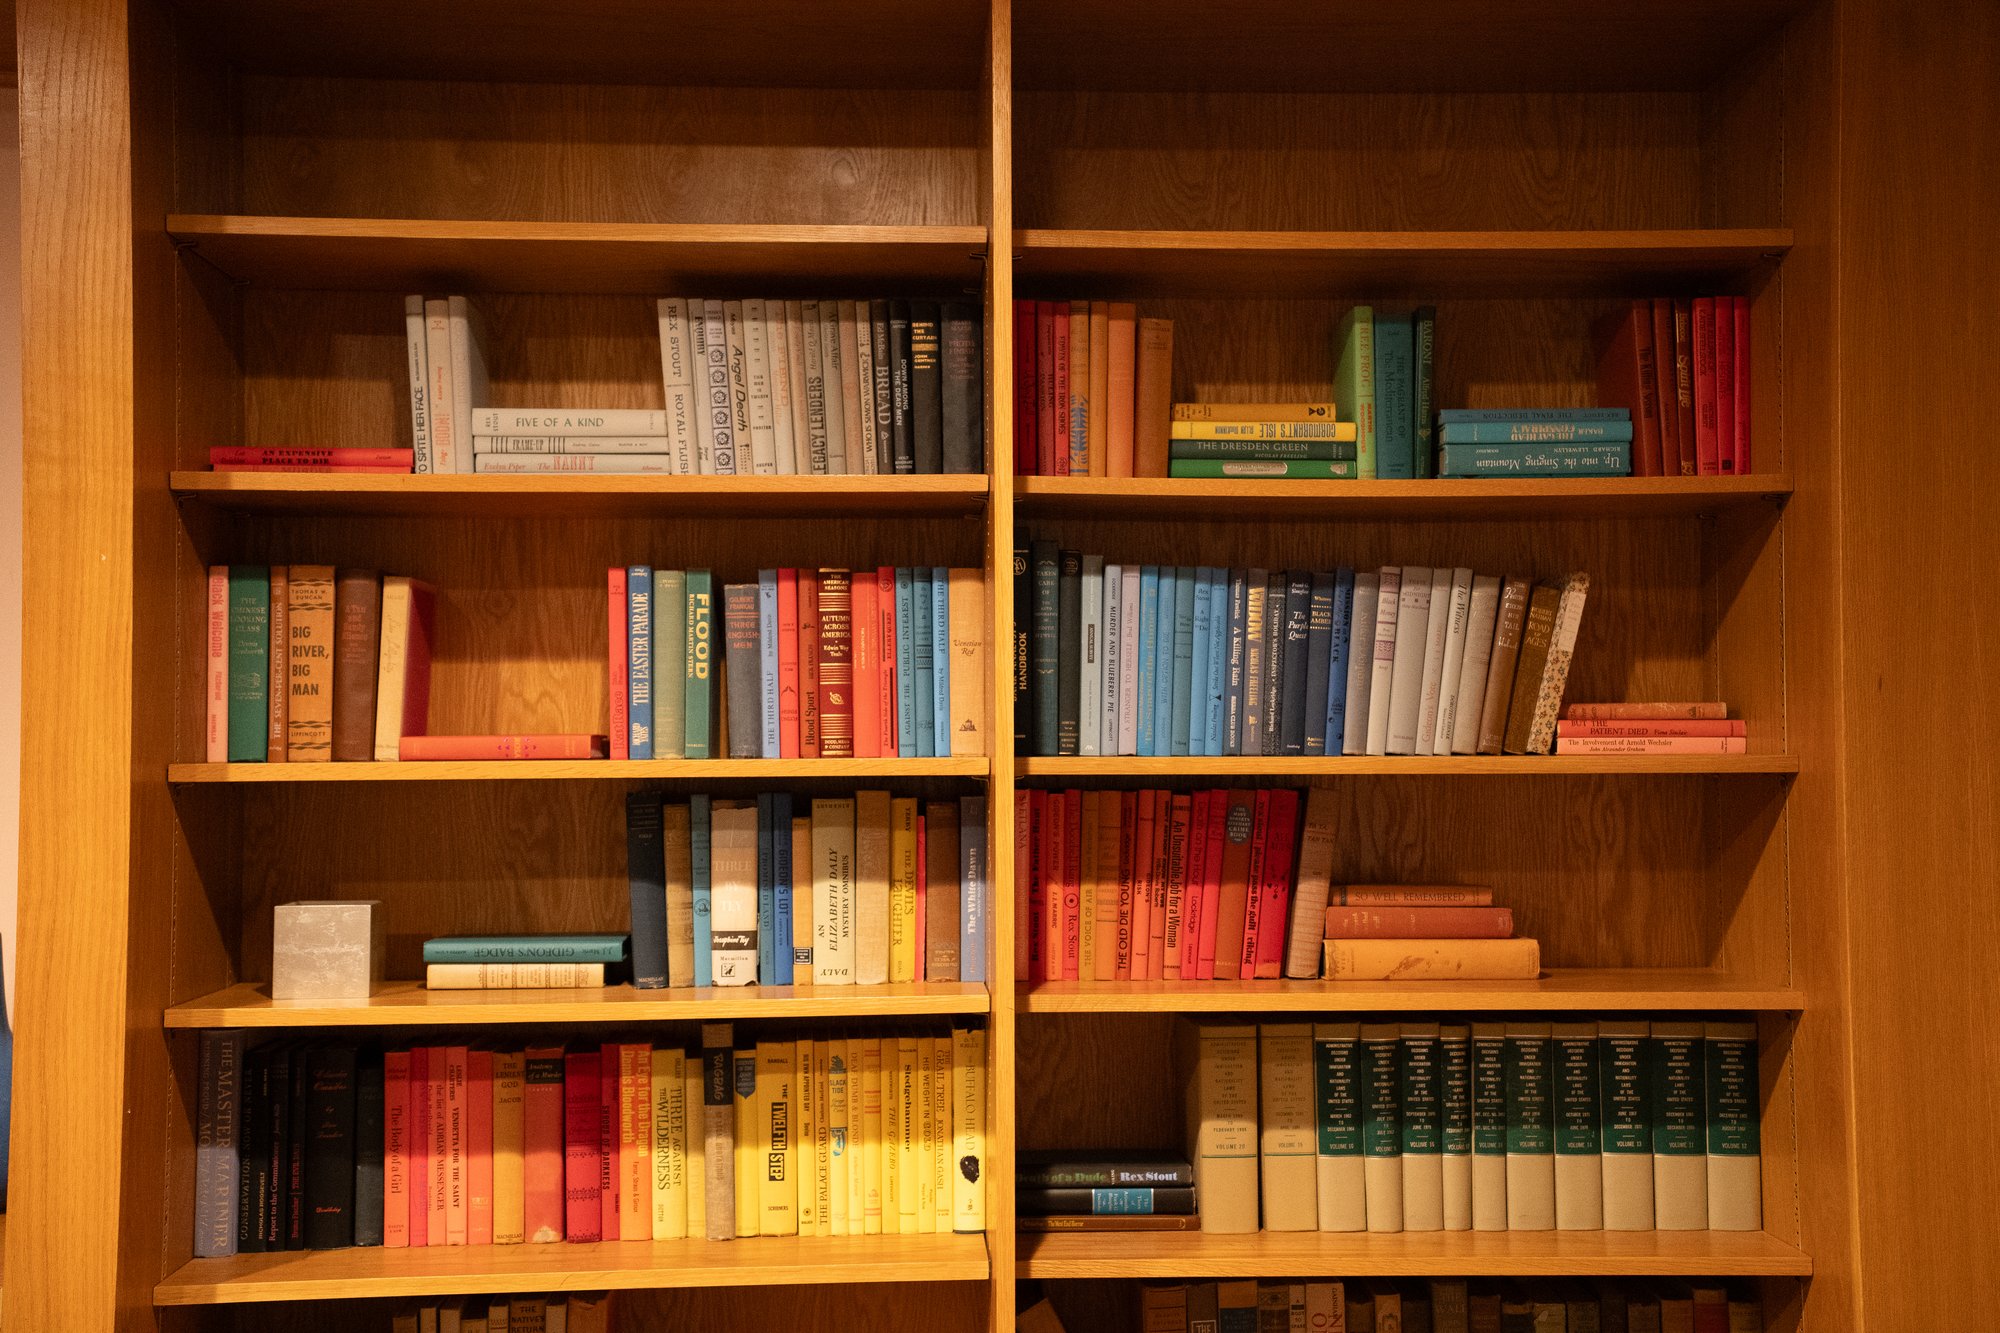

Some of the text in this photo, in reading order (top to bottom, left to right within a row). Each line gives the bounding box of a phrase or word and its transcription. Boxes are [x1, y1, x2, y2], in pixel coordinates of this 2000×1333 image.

[667, 304, 682, 378] REX STOUT
[730, 344, 748, 432] Angel Death
[875, 365, 891, 425] BREAD
[516, 417, 605, 428] FIVE OF A KIND
[1196, 441, 1309, 452] THE DRESDEN GREEN
[1476, 452, 1621, 470] Up, into the Singing Mountain
[821, 615, 851, 623] AUTUMN
[823, 623, 850, 631] ACROSS
[1108, 605, 1116, 637] MURDER
[1248, 586, 1265, 643] WIDOW
[1453, 583, 1467, 635] The Witness
[291, 626, 311, 638] BIG
[631, 592, 649, 706] THE EASTER PARADE
[695, 593, 710, 680] FLOOD
[821, 631, 851, 639] AMERICA
[961, 647, 975, 657] Red
[1108, 639, 1116, 656] AND
[291, 645, 330, 660] RIVER,
[291, 664, 311, 677] BIG
[901, 596, 911, 736] AGAINST THE PUBLIC INTEREST
[1018, 632, 1028, 691] HANDBOOK
[1230, 626, 1241, 687] A Killing Rain
[291, 683, 319, 696] MAN
[1107, 659, 1116, 699] BLUEBERRY
[766, 670, 776, 745] THE THIRD HALF
[804, 690, 817, 746] Blood Sport
[1591, 720, 1608, 728] THE
[1172, 820, 1186, 833] An
[1170, 833, 1185, 879] Unsuitable
[778, 848, 789, 916] GIDEON'S LOT
[828, 847, 839, 952] ELIZABETH DALY
[966, 847, 977, 934] The White Dawn
[1168, 895, 1182, 909] for
[1169, 880, 1183, 895] Job
[1355, 892, 1466, 902] SO WELL REMEMBERED
[817, 924, 825, 938] AN
[1085, 906, 1092, 918] OF
[1117, 869, 1130, 971] THE OLD DIE YOUNG
[1166, 915, 1181, 949] Woman
[1187, 894, 1199, 935] Lockridge
[473, 947, 575, 957] GIDEON'S BADGE
[1067, 914, 1077, 958] Rex Stout
[1084, 920, 1092, 947] VOICE
[820, 968, 849, 976] DALY
[1084, 949, 1092, 967] THE
[621, 1050, 636, 1144] Dennis Bloodworth
[713, 1053, 724, 1101] RAGBAG
[391, 1104, 403, 1124] The
[633, 1051, 651, 1157] An Eye for the Dragon
[903, 1064, 913, 1153] Sledgehammer
[935, 1049, 945, 1191] GRAIL TREE JONATHAN GASH
[964, 1064, 976, 1152] BUFFALO HEAD
[212, 1040, 233, 1250] THE MASTER MARINER
[389, 1127, 403, 1152] Body
[656, 1099, 671, 1191] WILDERNESS
[669, 1088, 683, 1187] THREE AGAINST
[771, 1102, 787, 1150] TWELFTH
[391, 1154, 403, 1166] of
[451, 1107, 460, 1209] VENDETTA FOR THE SAINT
[768, 1153, 784, 1182] STEP
[817, 1126, 828, 1226] THE PALACE GUARD
[1119, 1171, 1178, 1182] Rex Stout
[391, 1174, 403, 1194] Girl
